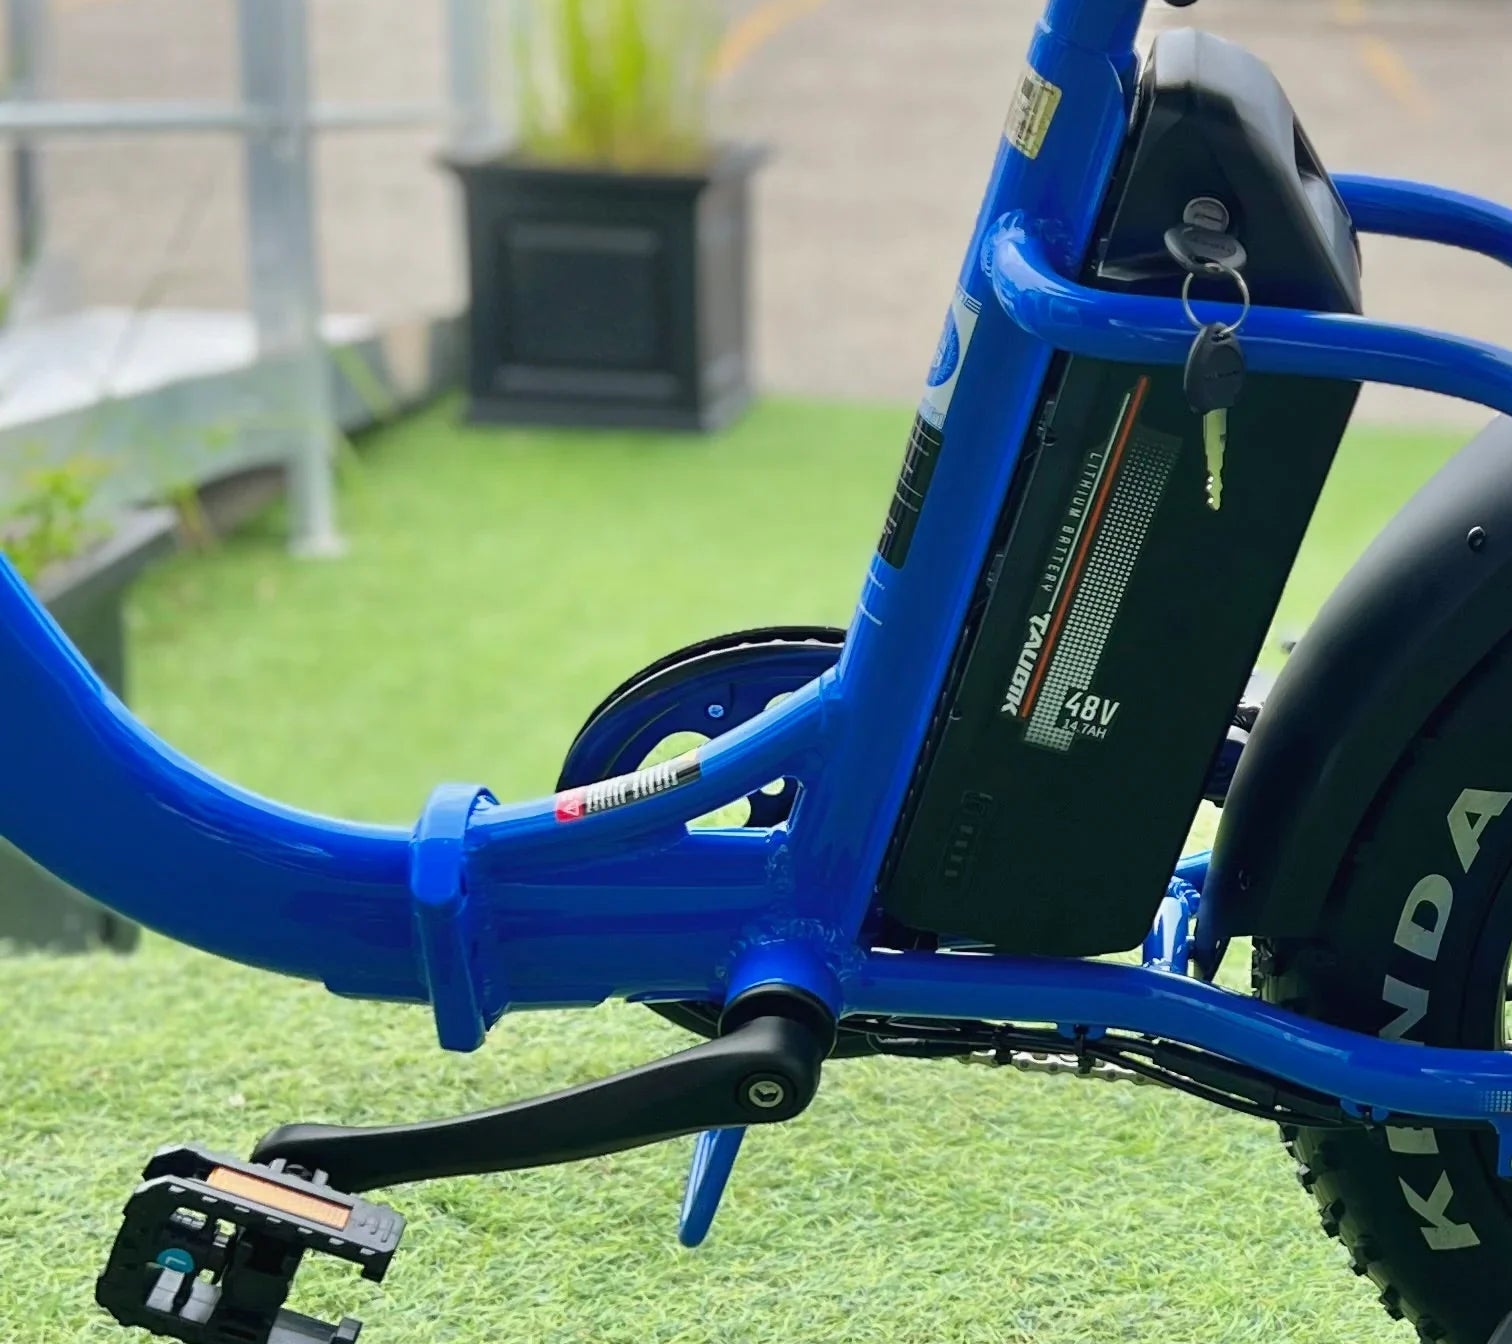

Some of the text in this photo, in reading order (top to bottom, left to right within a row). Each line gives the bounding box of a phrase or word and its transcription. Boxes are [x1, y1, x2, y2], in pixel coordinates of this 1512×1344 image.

[1041, 451, 1103, 592] LITHIUM BATTERY
[1064, 691, 1121, 726] 48V
